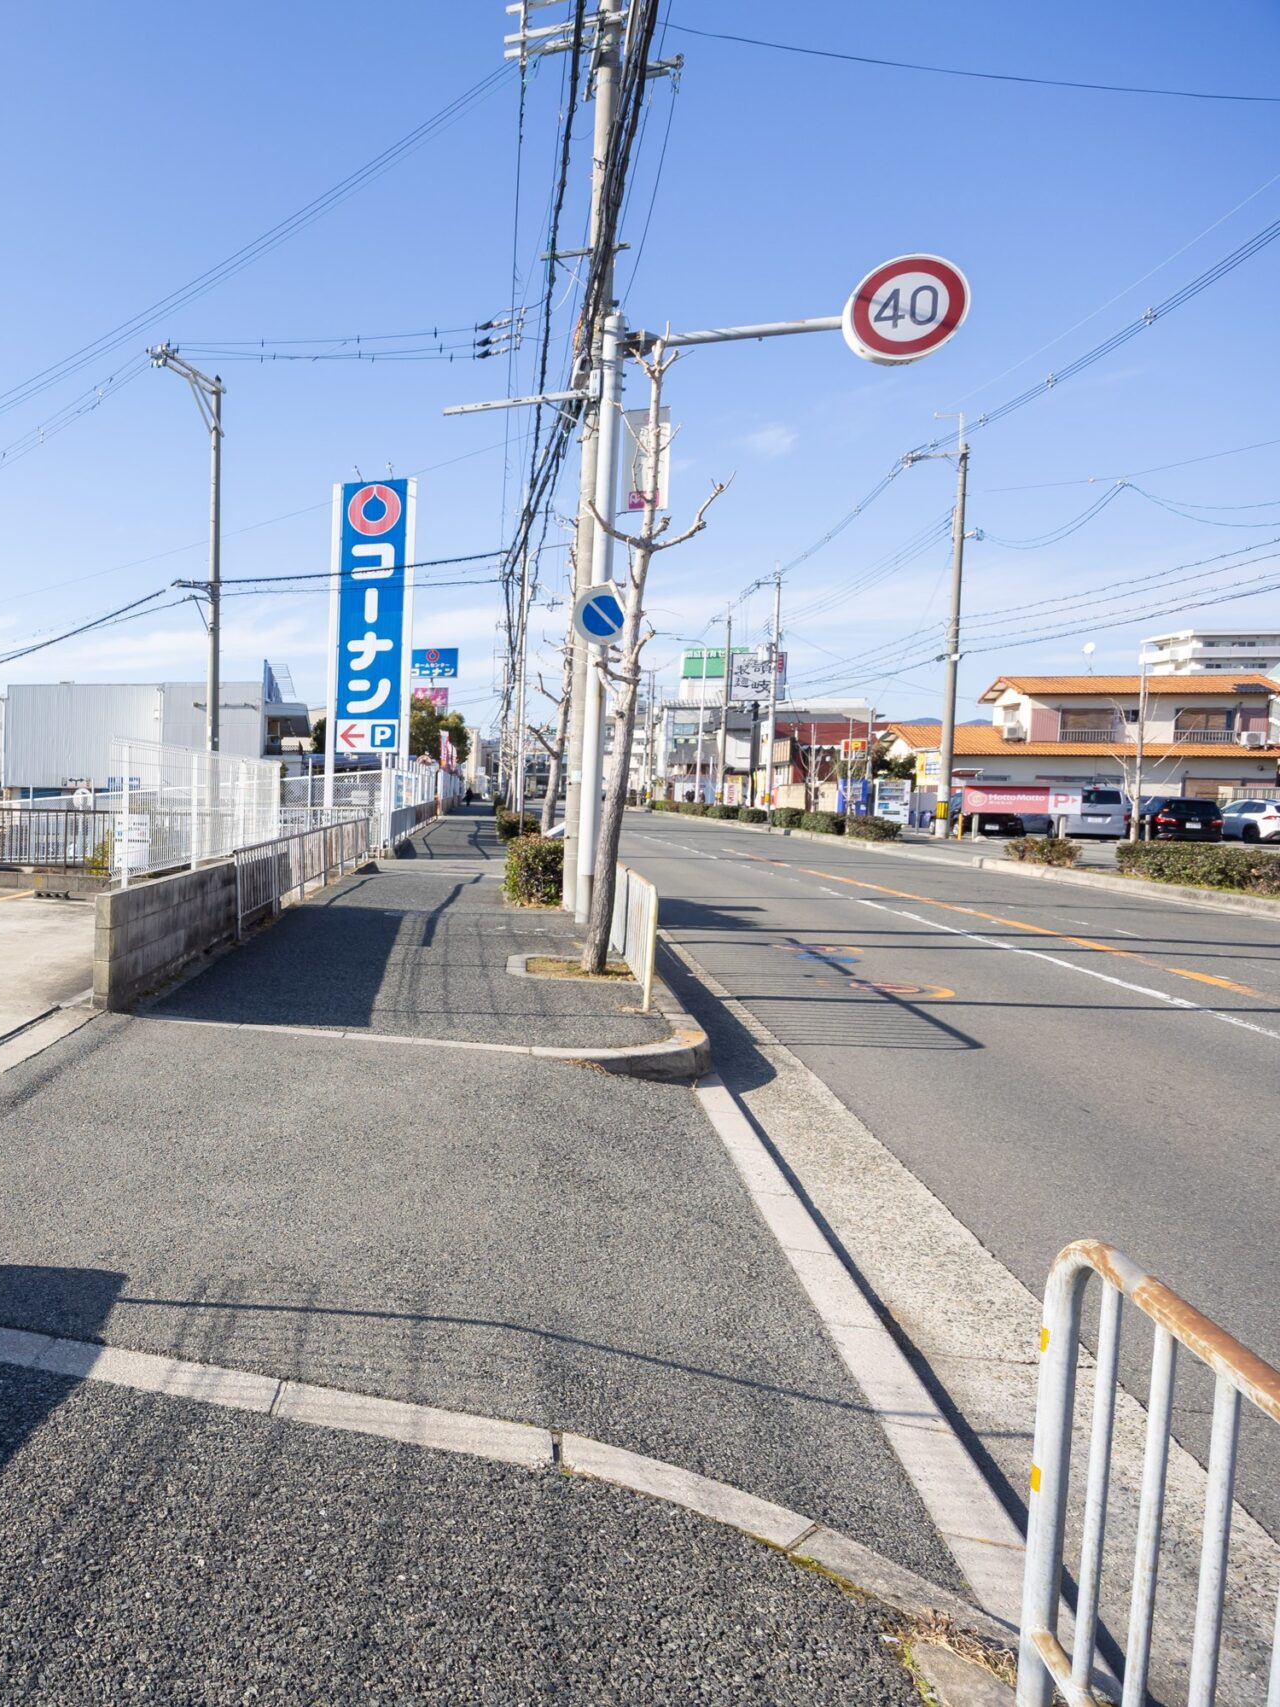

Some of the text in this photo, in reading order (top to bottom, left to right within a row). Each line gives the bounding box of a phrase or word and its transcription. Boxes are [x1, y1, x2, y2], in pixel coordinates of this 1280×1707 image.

[873, 285, 939, 329] 40
[346, 543, 395, 714] コーナン
[411, 667, 455, 677] コーナン
[374, 726, 392, 746] P
[1053, 793, 1070, 808] P
